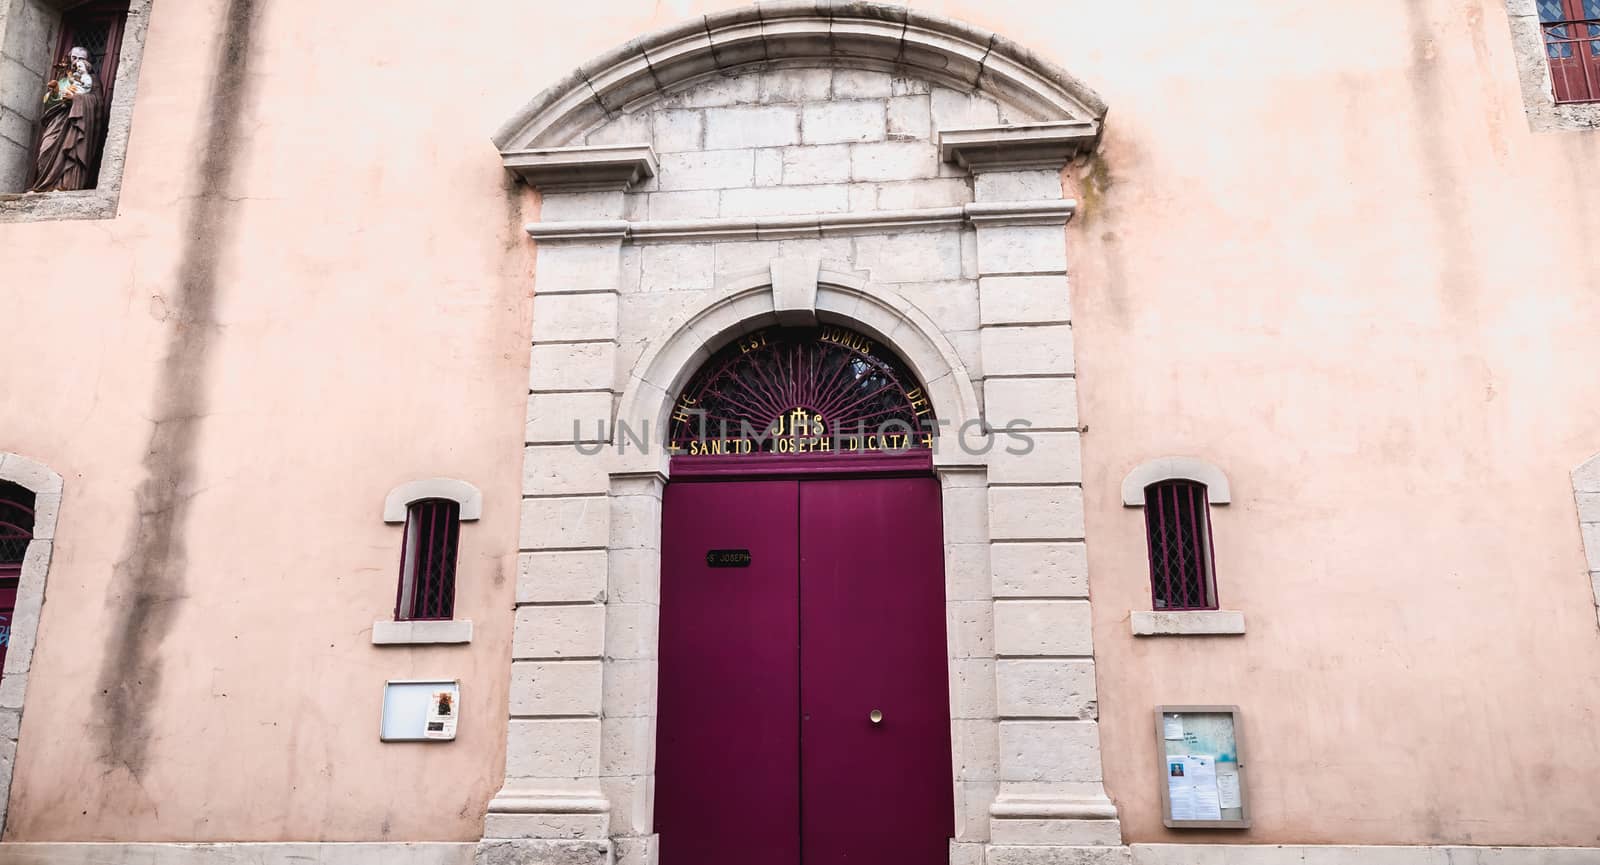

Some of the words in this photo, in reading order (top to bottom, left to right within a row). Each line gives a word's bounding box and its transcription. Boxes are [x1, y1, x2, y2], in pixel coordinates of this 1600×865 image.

[672, 393, 697, 423] HIC
[738, 331, 768, 353] EST
[821, 327, 873, 354] DOMUS
[906, 387, 930, 416] DEI
[690, 439, 752, 456] SANCTO
[770, 436, 830, 454] JOSEPH
[850, 433, 909, 451] DICATA
